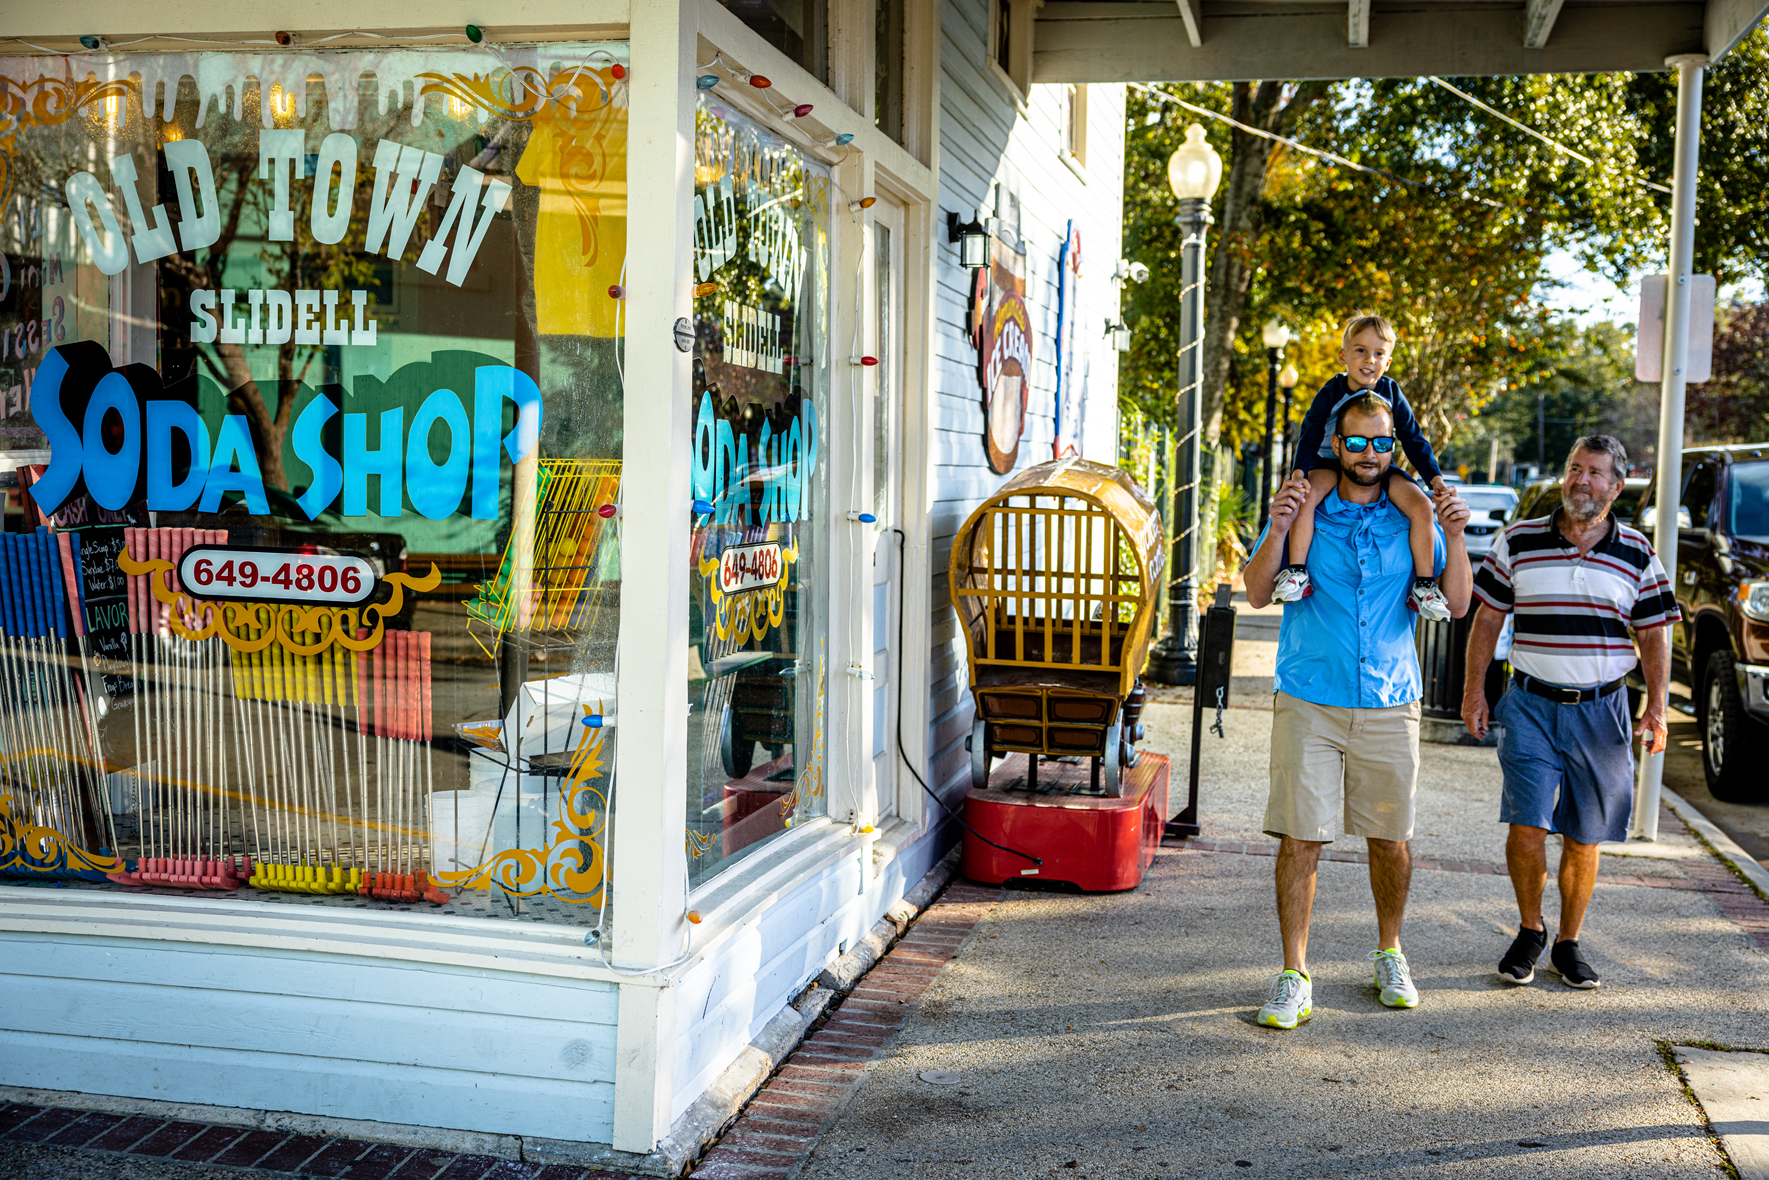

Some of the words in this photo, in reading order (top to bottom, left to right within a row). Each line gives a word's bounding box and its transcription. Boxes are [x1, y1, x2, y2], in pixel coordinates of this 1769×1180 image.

[65, 139, 221, 276] OLD
[258, 129, 512, 287] TOWN
[694, 174, 737, 282] OLD
[746, 178, 807, 316] TOWN
[190, 289, 377, 346] SLIDELL
[723, 299, 783, 374] SLIDELL
[986, 336, 1003, 404] ICE
[1003, 321, 1031, 389] CREAM
[29, 346, 270, 517] SODA
[292, 365, 543, 520] SHOP
[758, 398, 818, 528] SHOP
[193, 558, 362, 594] 649-4806
[724, 547, 777, 587] 649-4806
[86, 602, 129, 633] LAVOR
[99, 636, 119, 652] Vanilla
